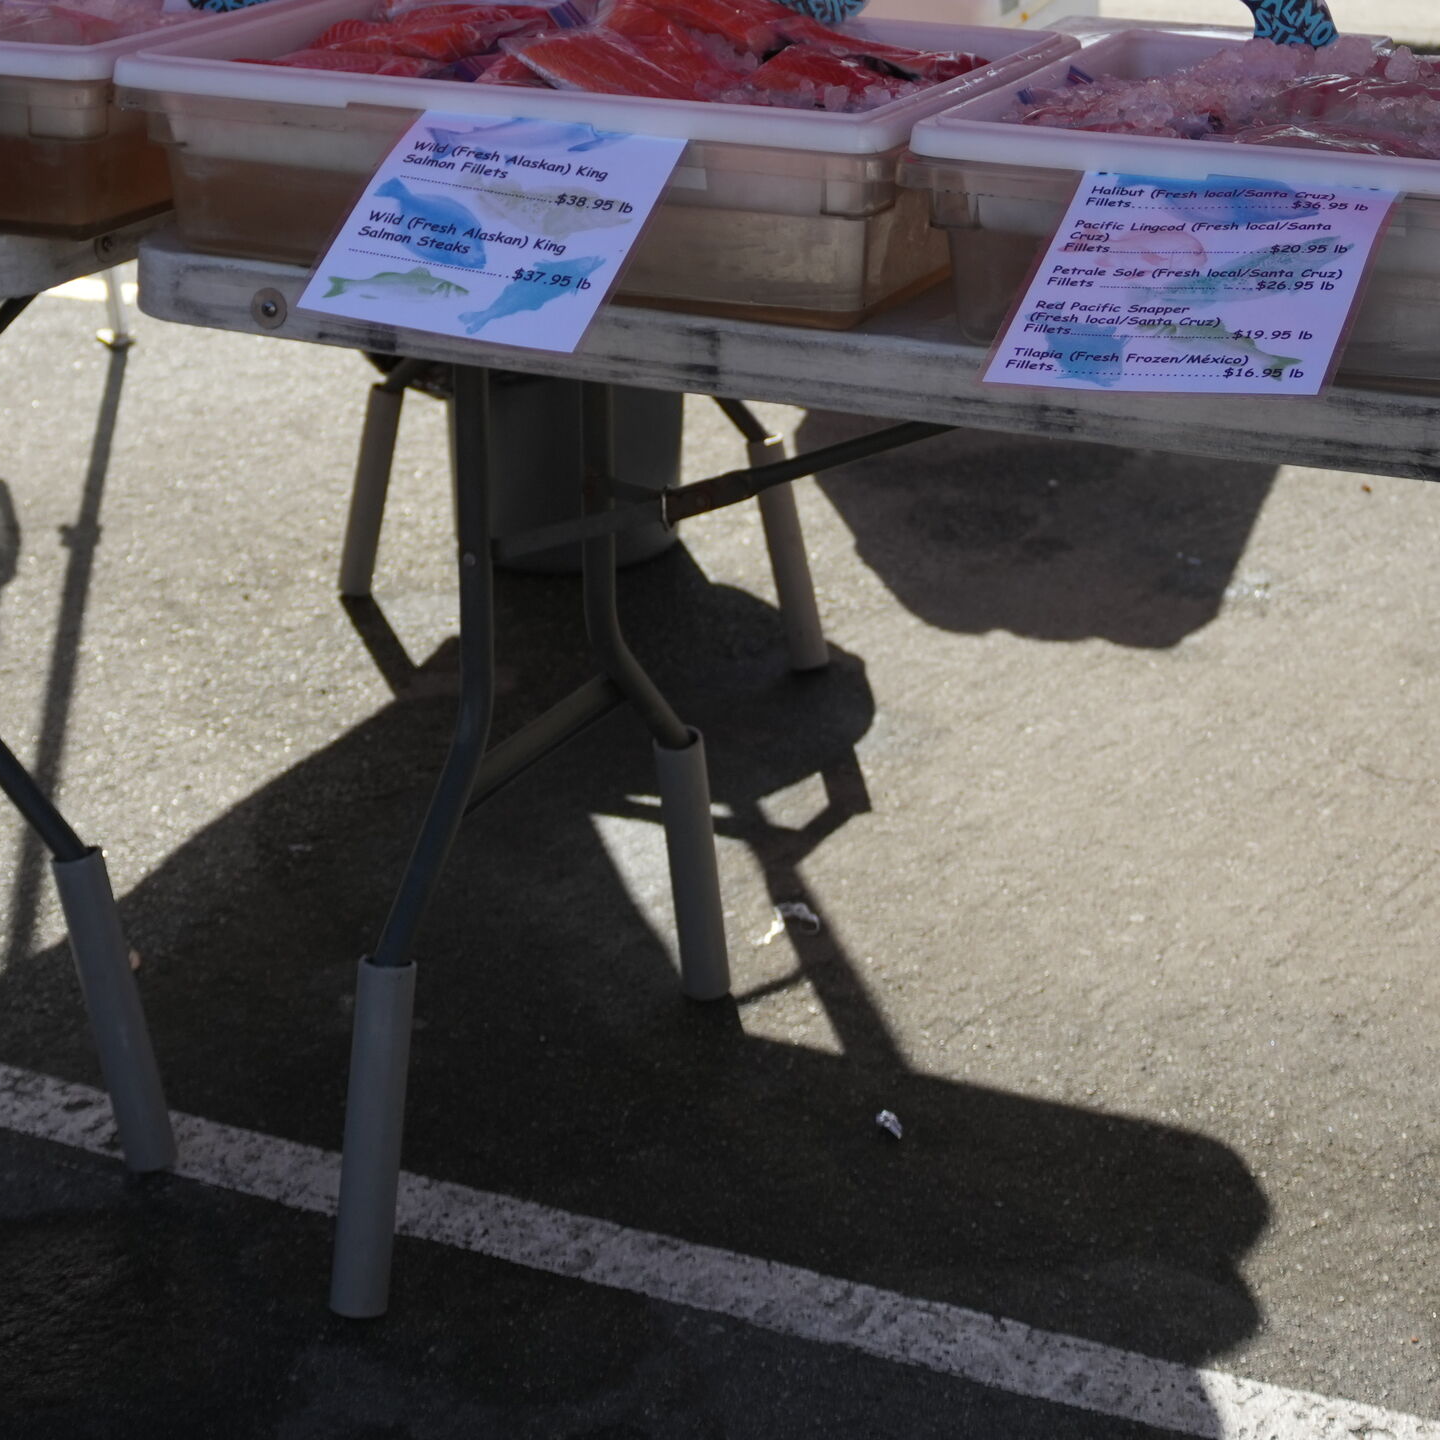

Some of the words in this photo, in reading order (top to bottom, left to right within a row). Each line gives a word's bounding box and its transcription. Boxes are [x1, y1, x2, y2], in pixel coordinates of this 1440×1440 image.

[402, 153, 456, 171] Salmon
[460, 162, 509, 180] Fillets
[413, 140, 448, 155] Wild
[451, 145, 501, 163] (Fresh
[504, 153, 571, 176] Alaskan)
[576, 165, 609, 183] King
[1090, 185, 1146, 198] Halibut
[1150, 187, 1201, 201] (Fresh
[1203, 188, 1291, 201] local/Santa
[1293, 191, 1337, 202] Cruz)
[554, 193, 615, 213] $38.95
[1085, 197, 1131, 210] Fillets
[1291, 199, 1351, 211] $36.95
[368, 210, 404, 226] Wild
[407, 215, 457, 236] (Fresh
[461, 225, 529, 250] Alaskan)
[533, 237, 567, 256] King
[1074, 219, 1124, 233] Pacific
[1130, 222, 1186, 234] Lingcod
[1191, 221, 1242, 235] (Fresh
[1245, 221, 1332, 235] local/Santa
[357, 224, 412, 245] Salmon
[417, 236, 471, 255] Steaks
[1069, 231, 1110, 244] Cruz)
[1063, 242, 1111, 254] Fillets
[1270, 243, 1330, 255] $20.95
[512, 267, 571, 288] $37.95
[1052, 265, 1108, 279] Petrale
[1112, 267, 1146, 279] Sole
[1150, 267, 1203, 280] (Fresh
[1206, 268, 1297, 280] local/Santa
[1300, 268, 1344, 280] Cruz)
[1047, 277, 1094, 289] Fillets
[1256, 280, 1315, 291] $26.95
[1035, 300, 1066, 313] Red
[1069, 302, 1123, 316] Pacific
[1127, 304, 1191, 317] Snapper
[1023, 324, 1072, 337] Fillets
[1232, 329, 1292, 342] $19.95
[1013, 347, 1064, 363] Tilapia
[1069, 350, 1121, 365] (Fresh
[1005, 360, 1056, 374] Fillets
[1222, 367, 1283, 380] $16.95
